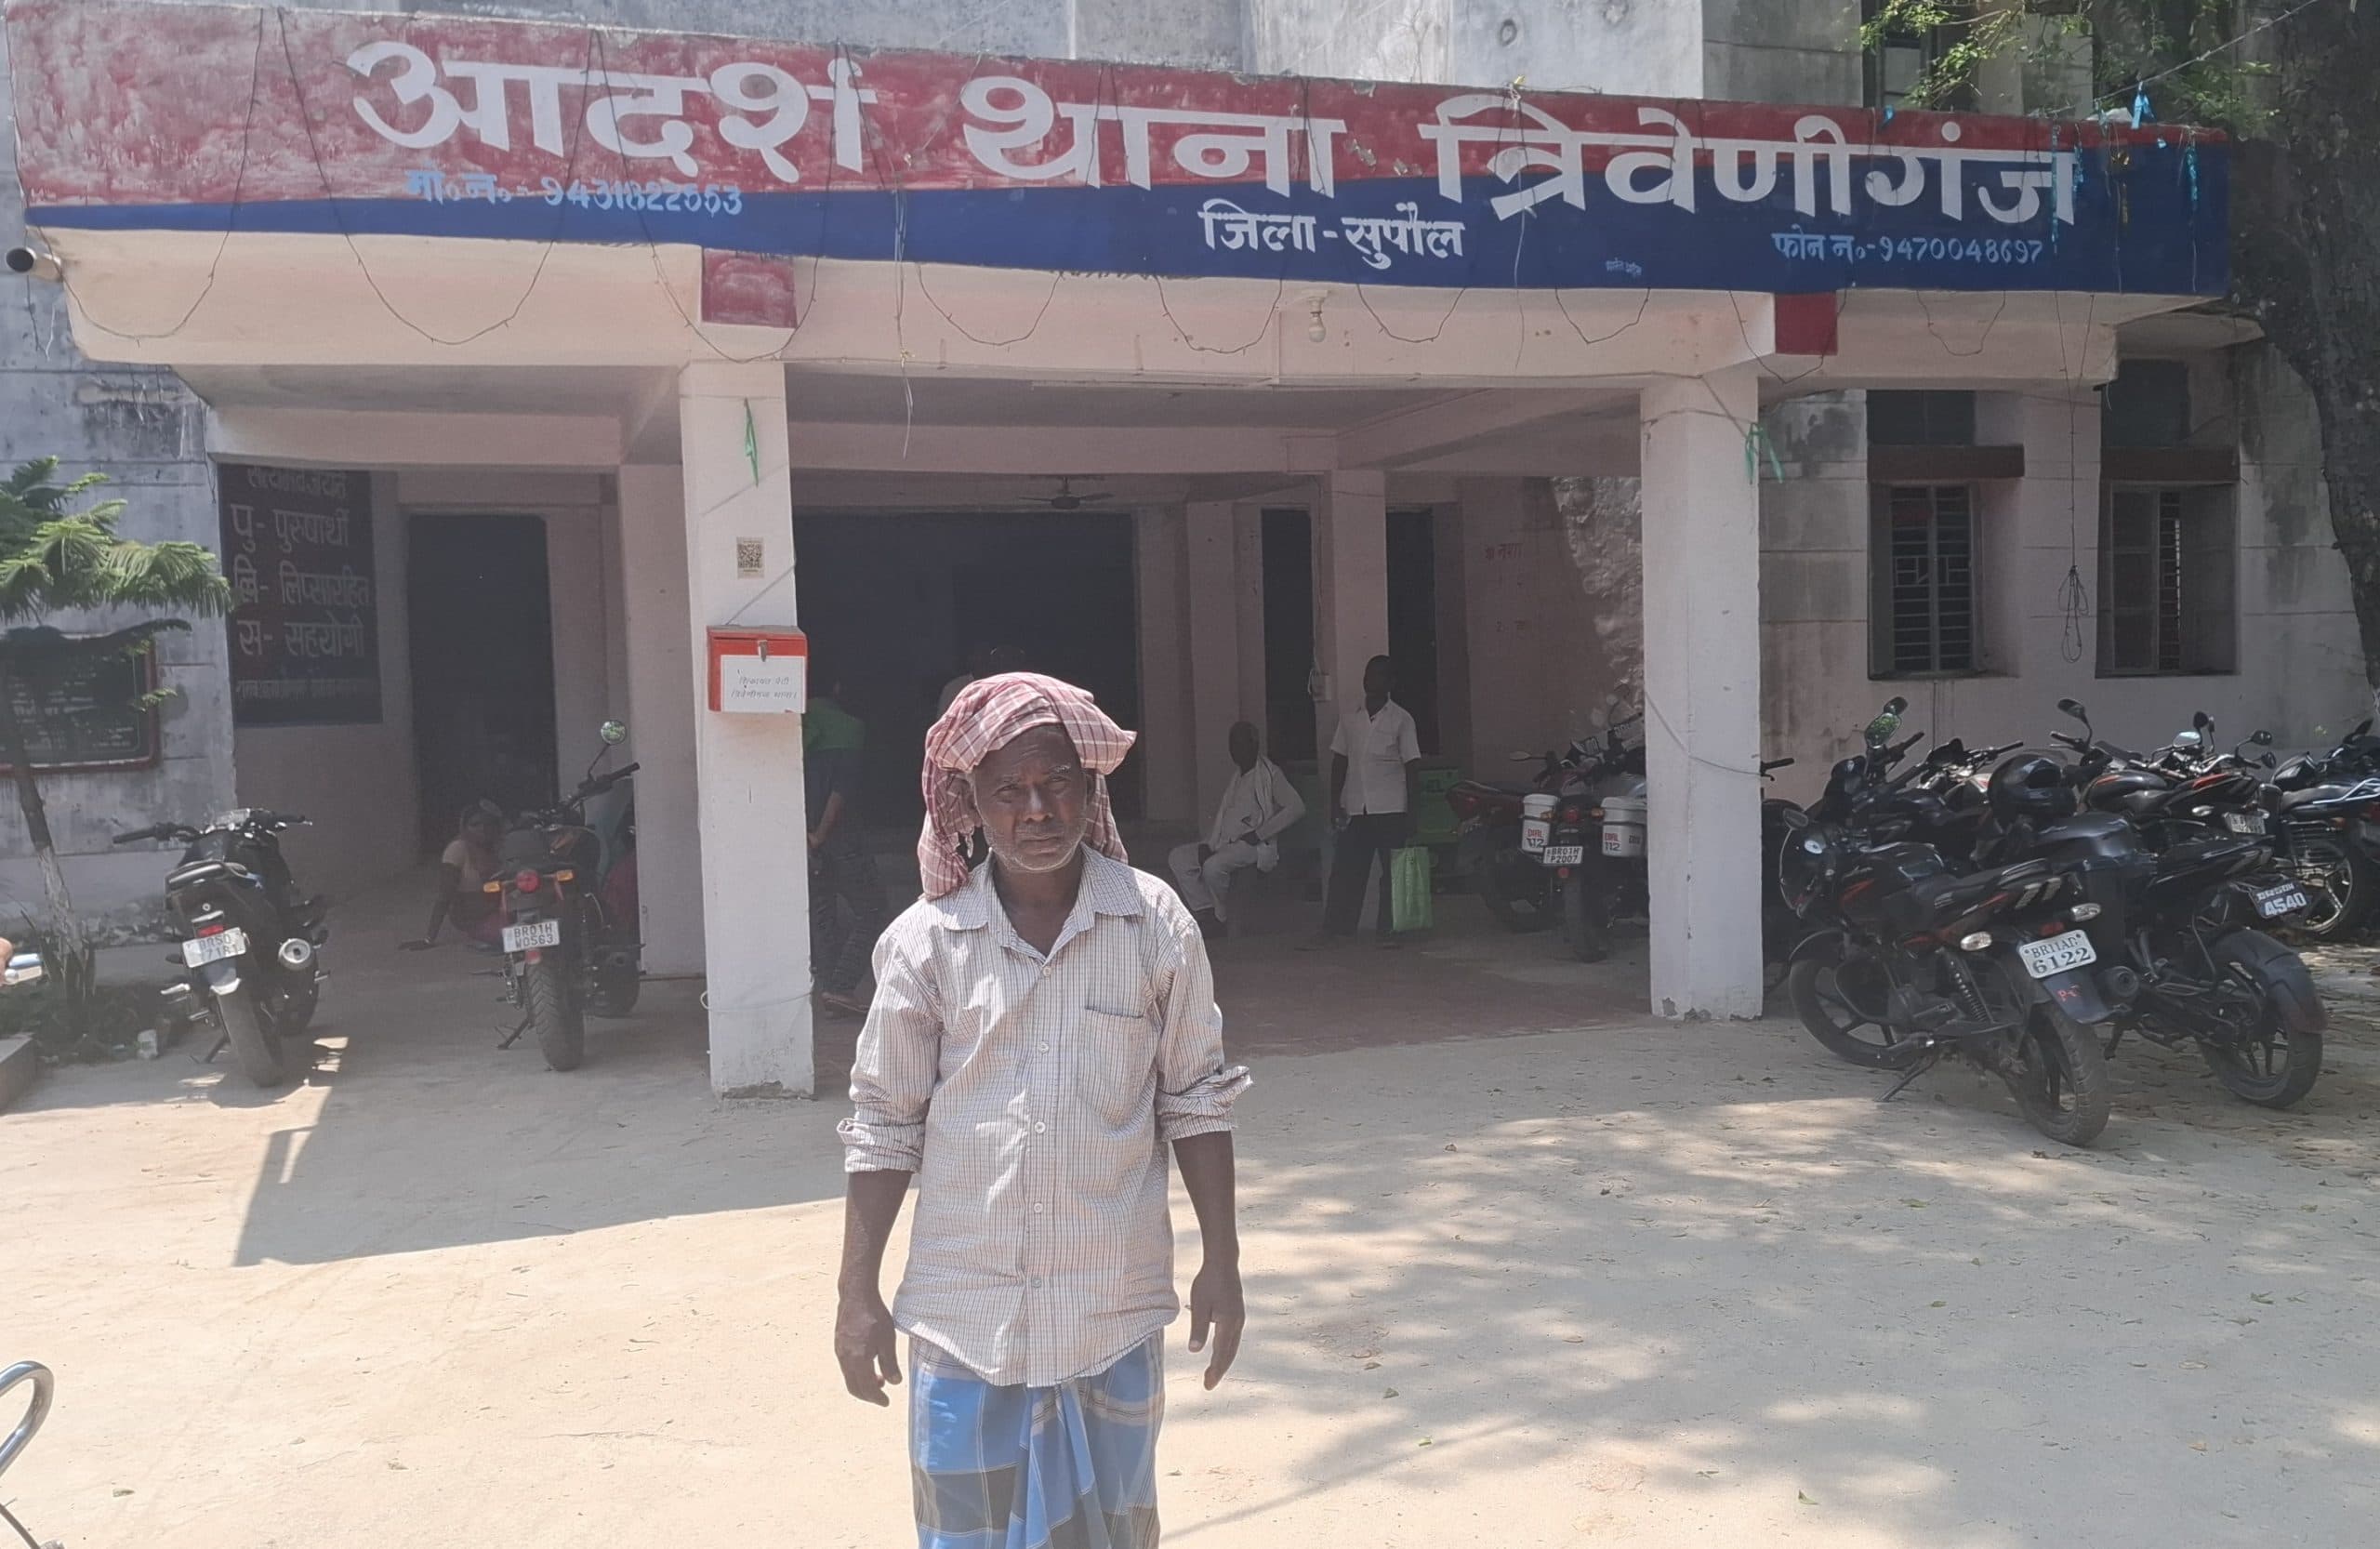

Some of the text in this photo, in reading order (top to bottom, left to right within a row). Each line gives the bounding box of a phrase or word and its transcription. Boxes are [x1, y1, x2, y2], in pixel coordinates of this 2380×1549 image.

[350, 41, 2079, 226] आदर्श थाना त्रिवेणीगंज
[2265, 892, 2307, 916] 4540
[2032, 947, 2091, 974] 6122
